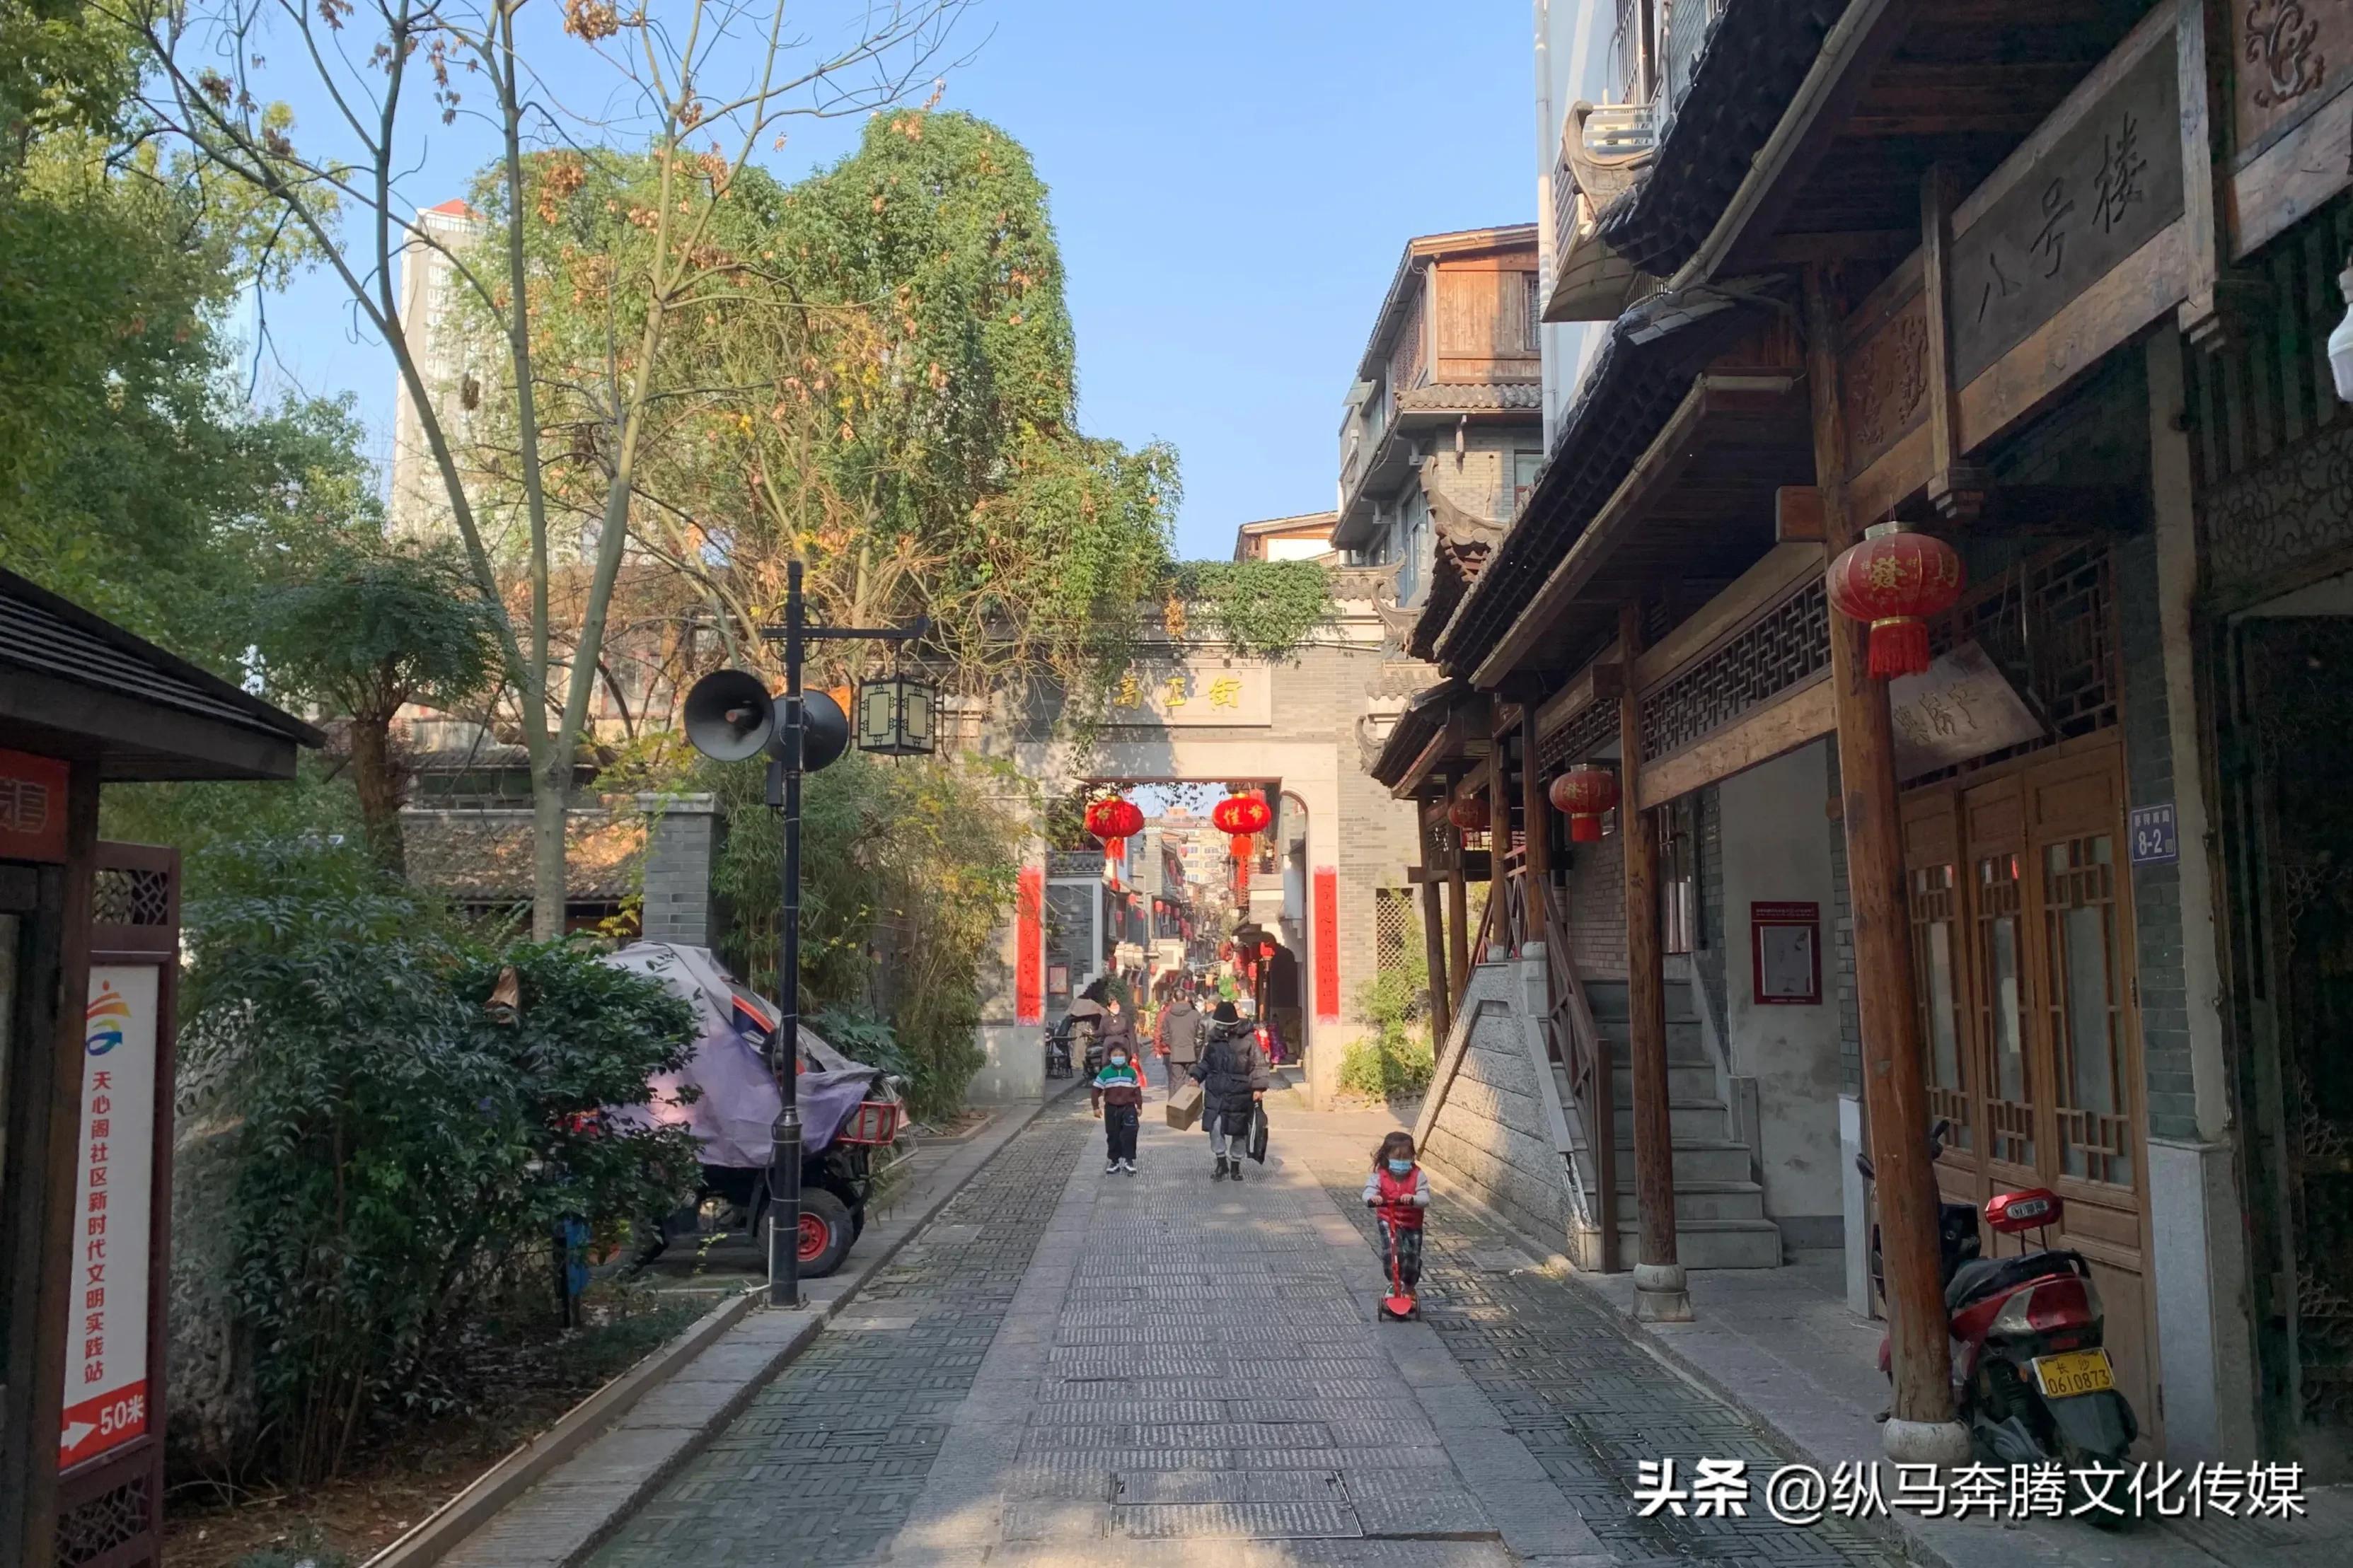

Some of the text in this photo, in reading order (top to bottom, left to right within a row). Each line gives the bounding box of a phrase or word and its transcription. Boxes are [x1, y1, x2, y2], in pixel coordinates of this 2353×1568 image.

[1978, 111, 2149, 323] 八号楼
[84, 1071, 112, 1384] 天心阁社区新时代文明实践站
[2047, 1369, 2110, 1395] 0610873
[2056, 1359, 2090, 1374] 长沙
[100, 1394, 144, 1436] 50米
